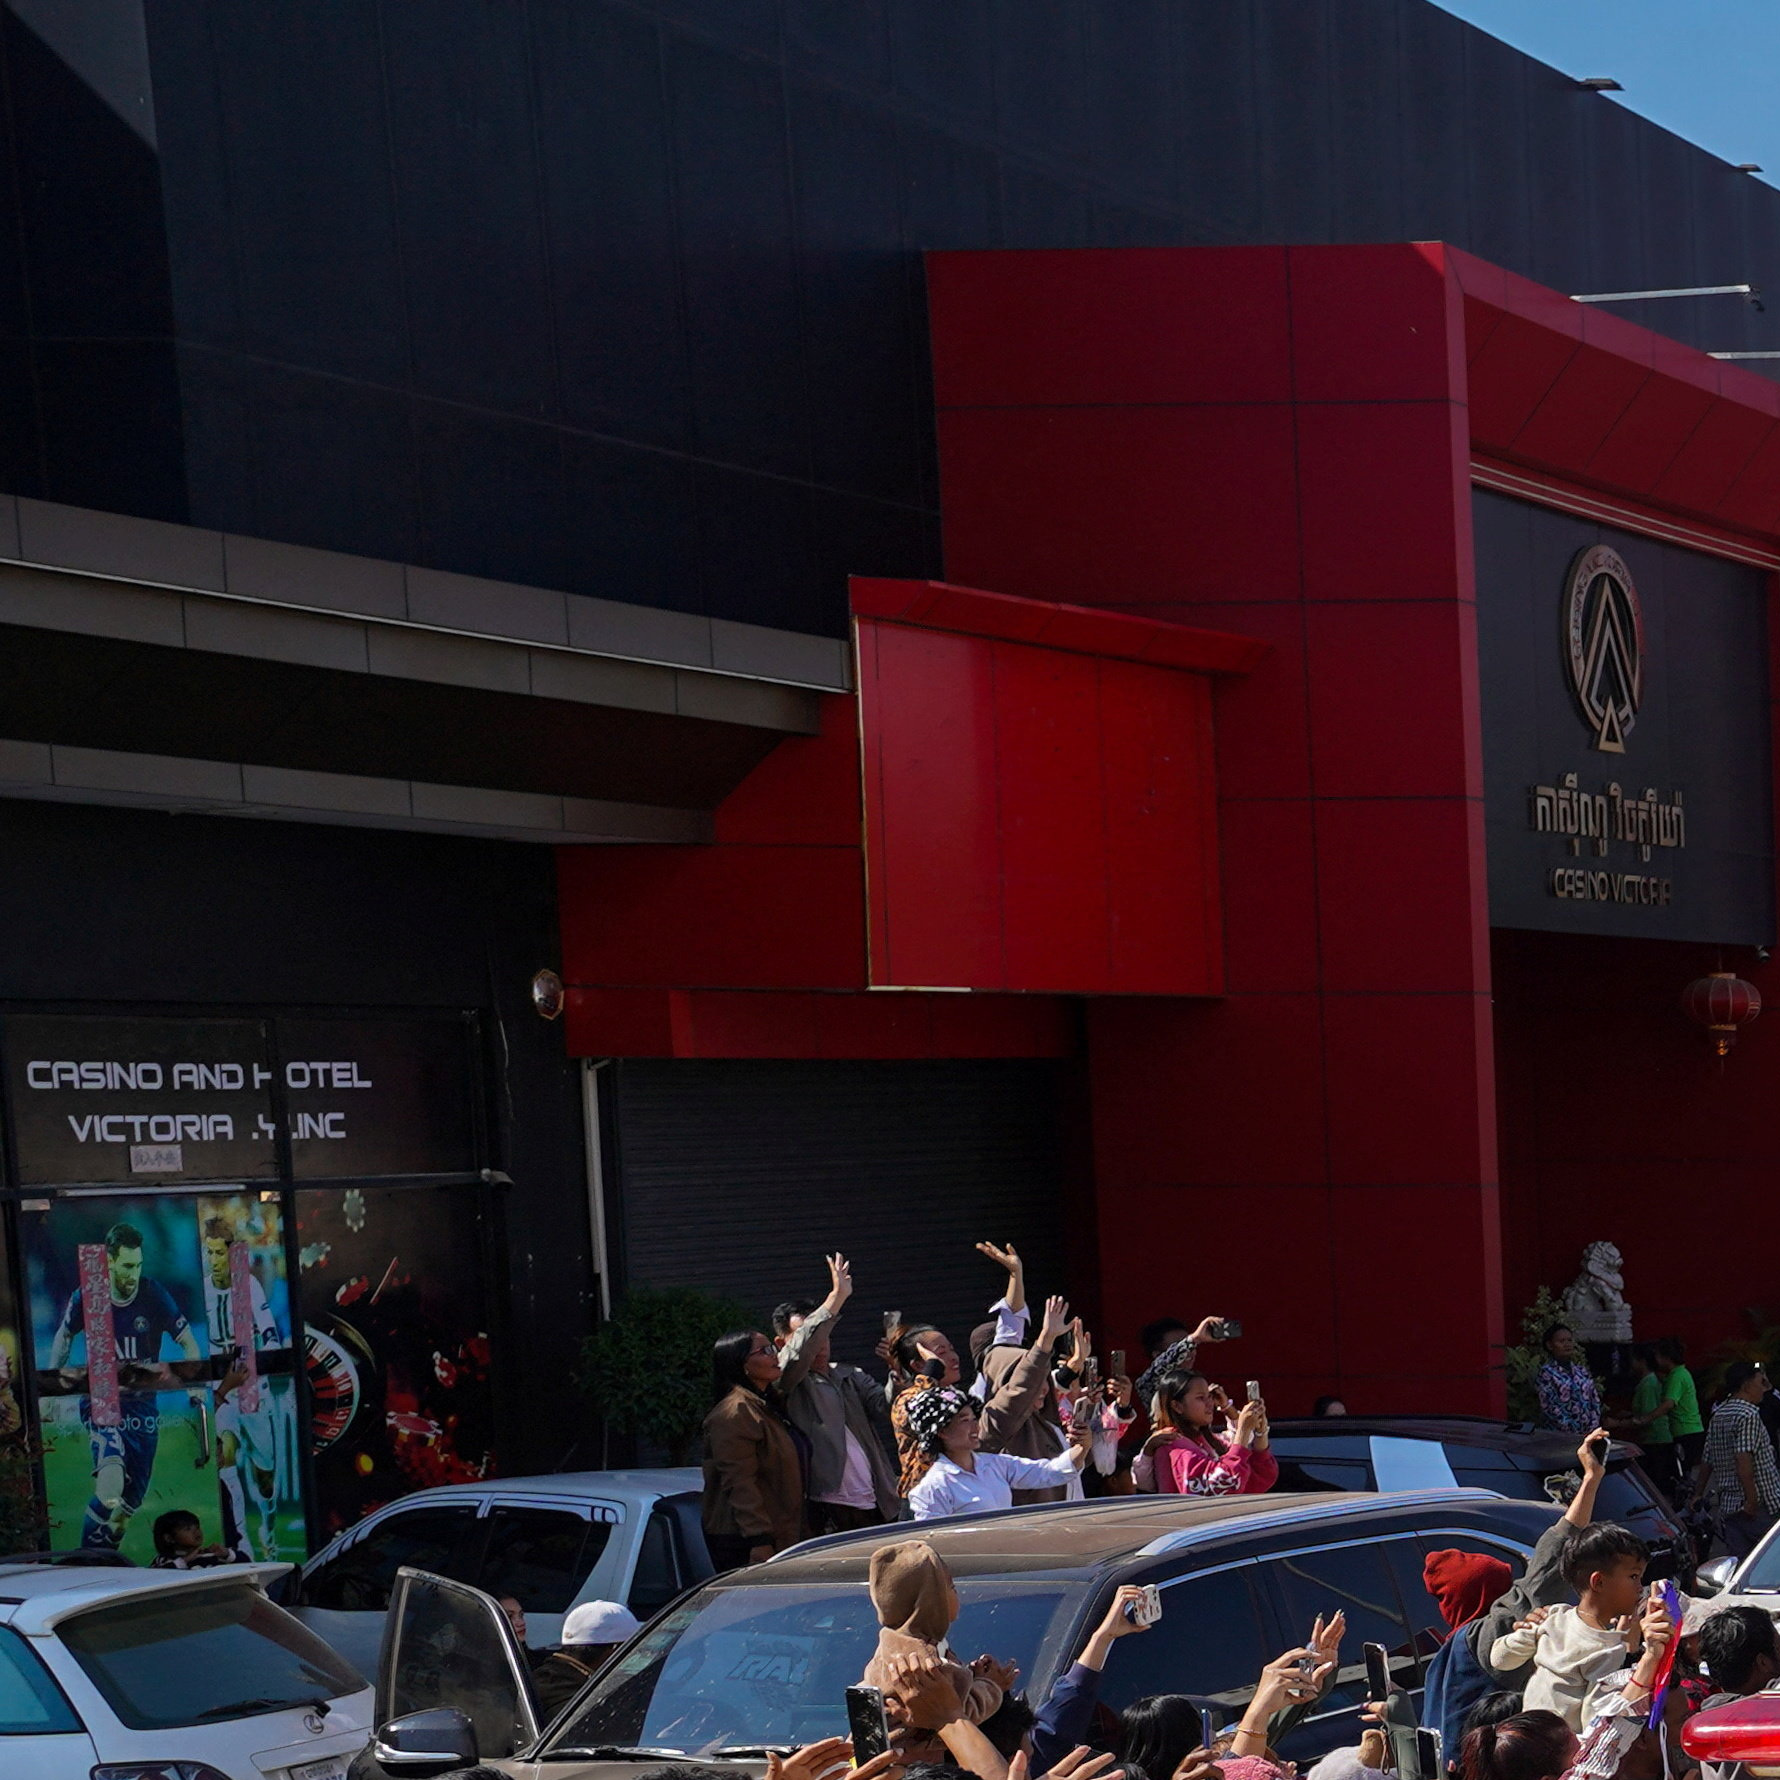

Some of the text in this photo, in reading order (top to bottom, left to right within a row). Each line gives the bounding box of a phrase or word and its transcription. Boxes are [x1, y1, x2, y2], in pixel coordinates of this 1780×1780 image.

[1553, 867, 1673, 906] CASINO VICTORIA
[25, 1060, 164, 1091] CASINO
[172, 1061, 244, 1091] AND
[68, 1113, 234, 1143] VICTORIA
